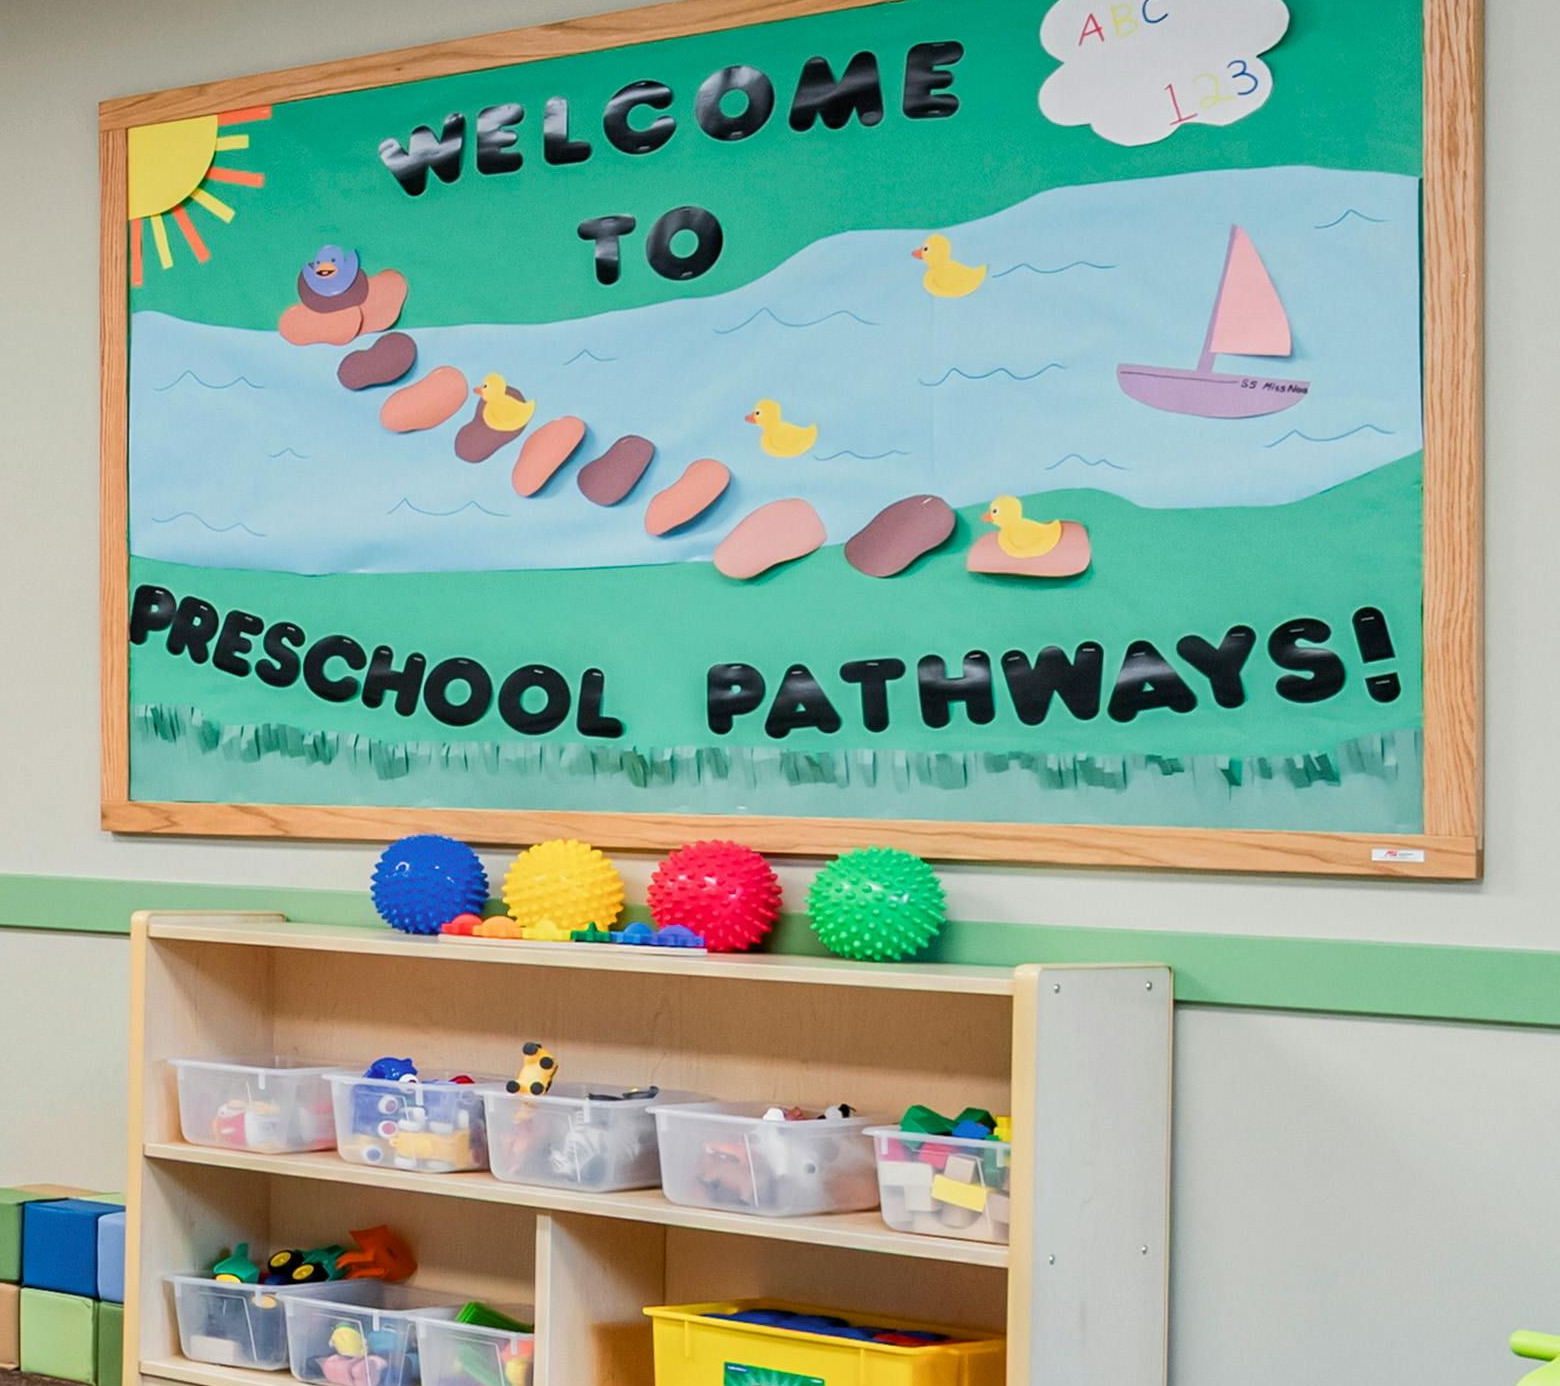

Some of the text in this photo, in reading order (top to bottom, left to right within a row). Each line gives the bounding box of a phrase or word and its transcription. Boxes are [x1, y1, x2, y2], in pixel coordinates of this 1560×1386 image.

[378, 40, 965, 198] WELCOME
[577, 205, 724, 286] TO
[130, 583, 1402, 740] PRESCHOOL PATHWAYS!
